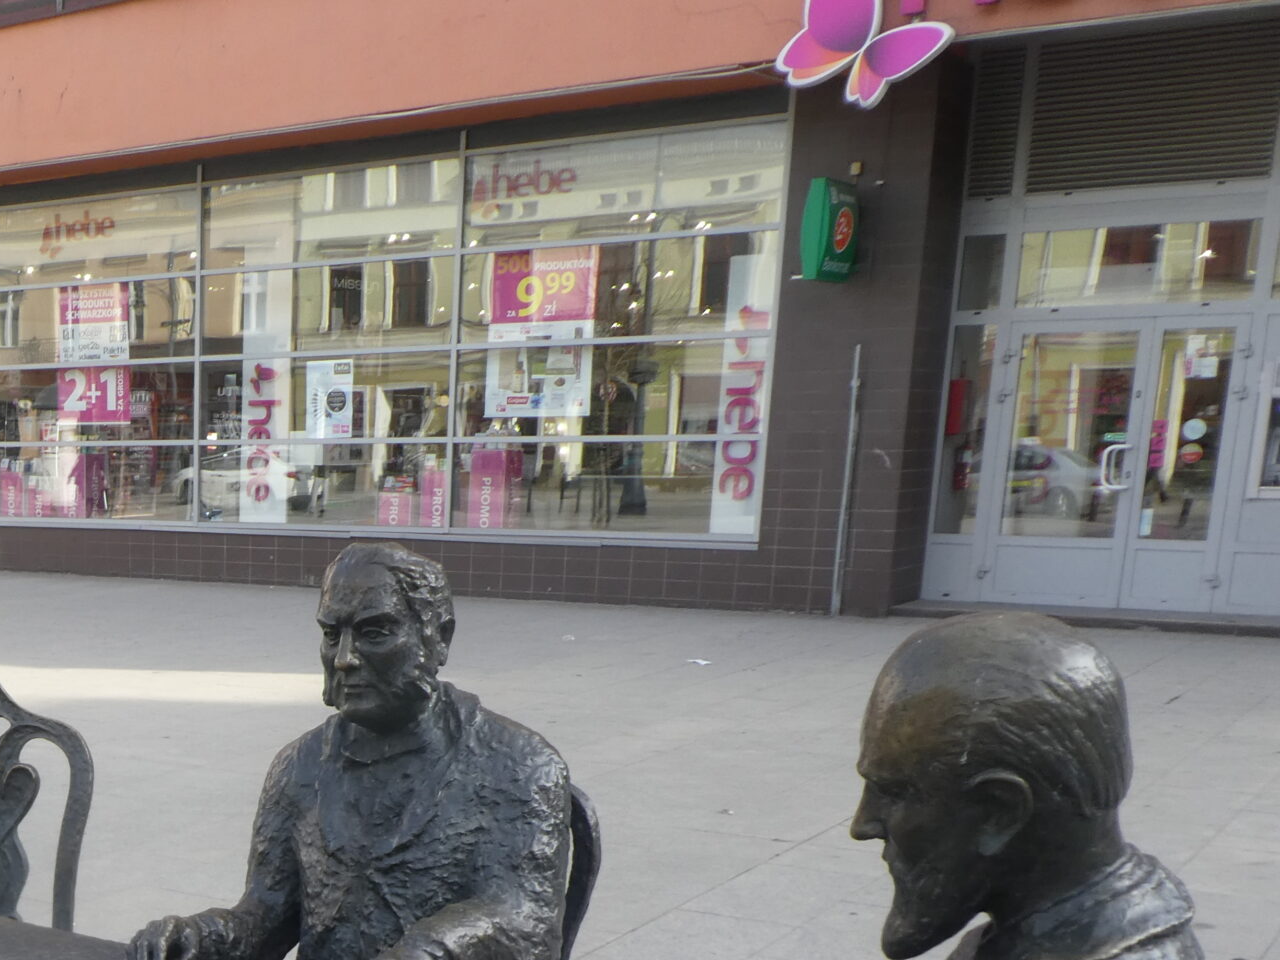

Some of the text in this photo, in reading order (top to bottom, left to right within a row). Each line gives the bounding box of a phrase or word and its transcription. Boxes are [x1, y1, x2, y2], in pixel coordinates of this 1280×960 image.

[492, 158, 577, 200] hebe
[54, 209, 116, 242] hebe
[496, 254, 594, 275] 500 PRODUKTÓW
[72, 299, 115, 311] PRODUKTY
[506, 310, 516, 318] ZA
[544, 300, 557, 316] zł
[62, 368, 117, 412] 2+1
[719, 360, 766, 501] hebe
[479, 476, 492, 528] PROMO
